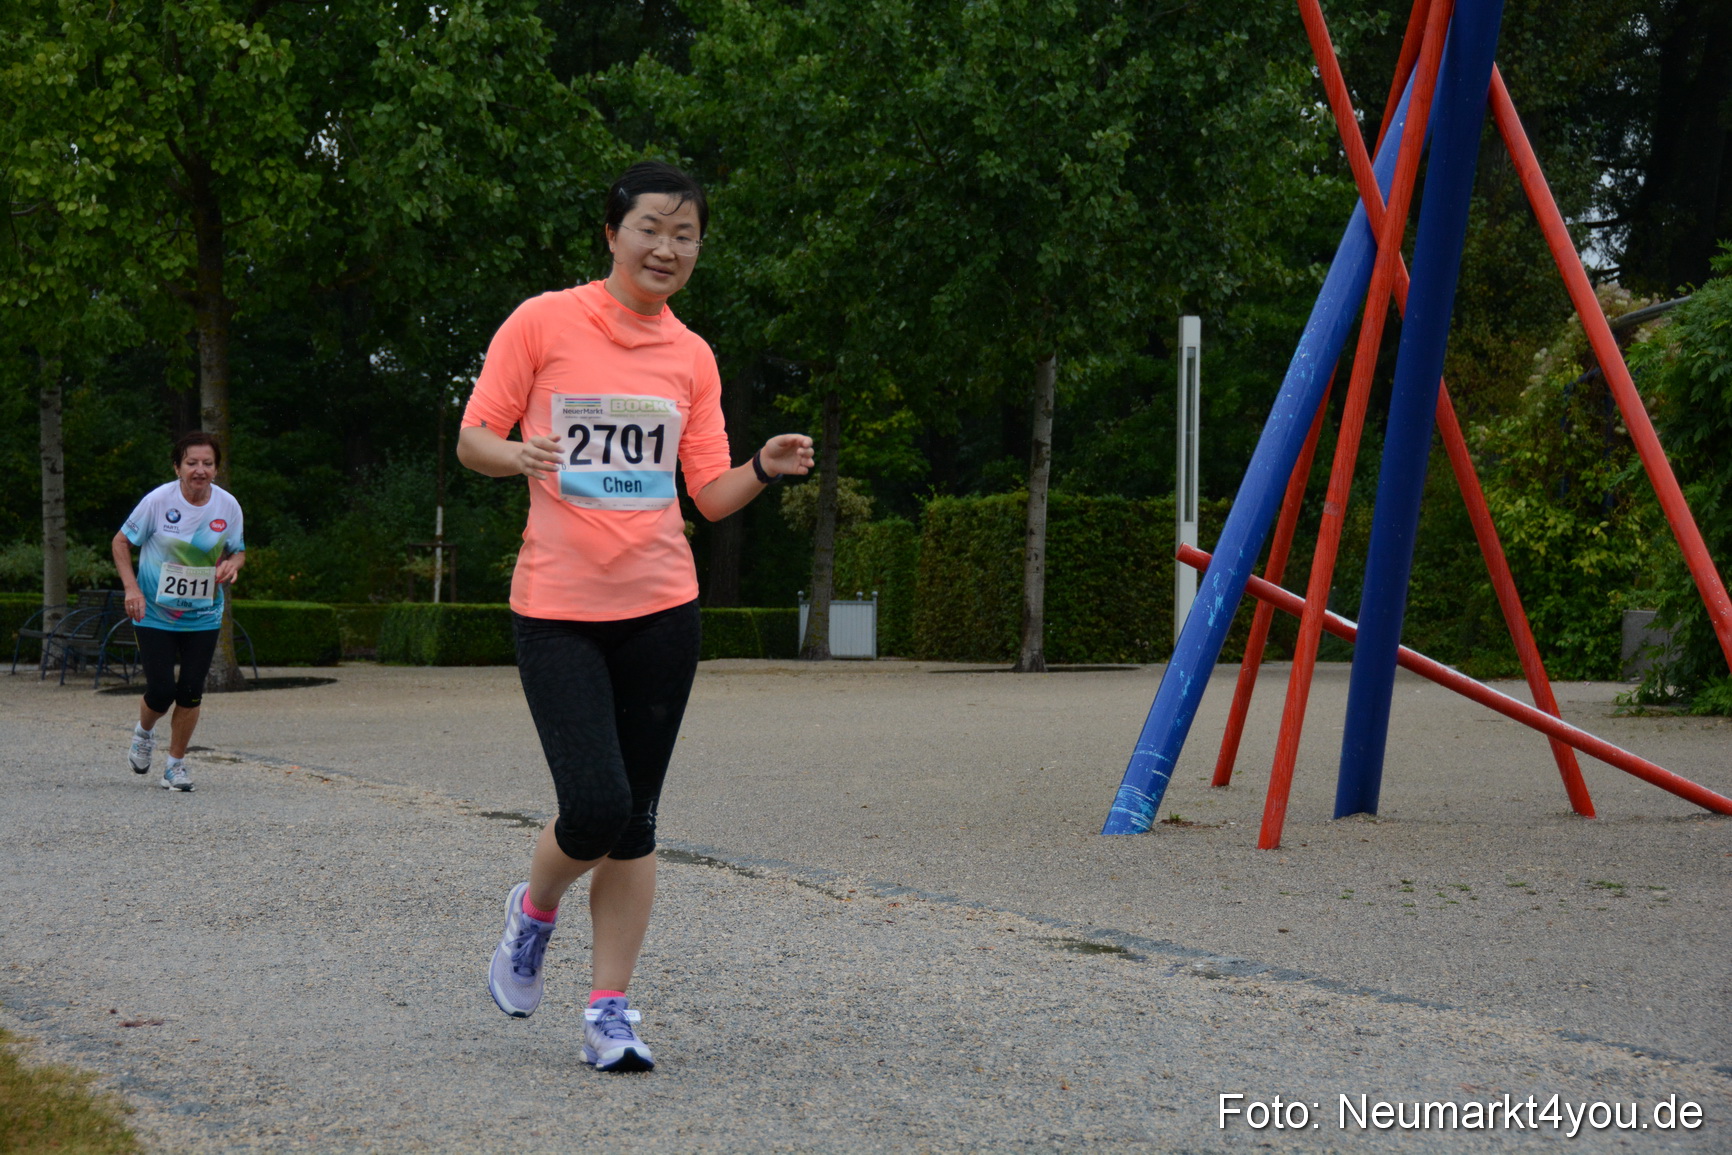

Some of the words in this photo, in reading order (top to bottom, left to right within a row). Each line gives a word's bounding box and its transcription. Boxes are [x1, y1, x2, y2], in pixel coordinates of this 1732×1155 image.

[610, 399, 670, 413] BOCK
[567, 424, 665, 466] 2701
[602, 476, 643, 493] Chen
[164, 576, 209, 597] 2611
